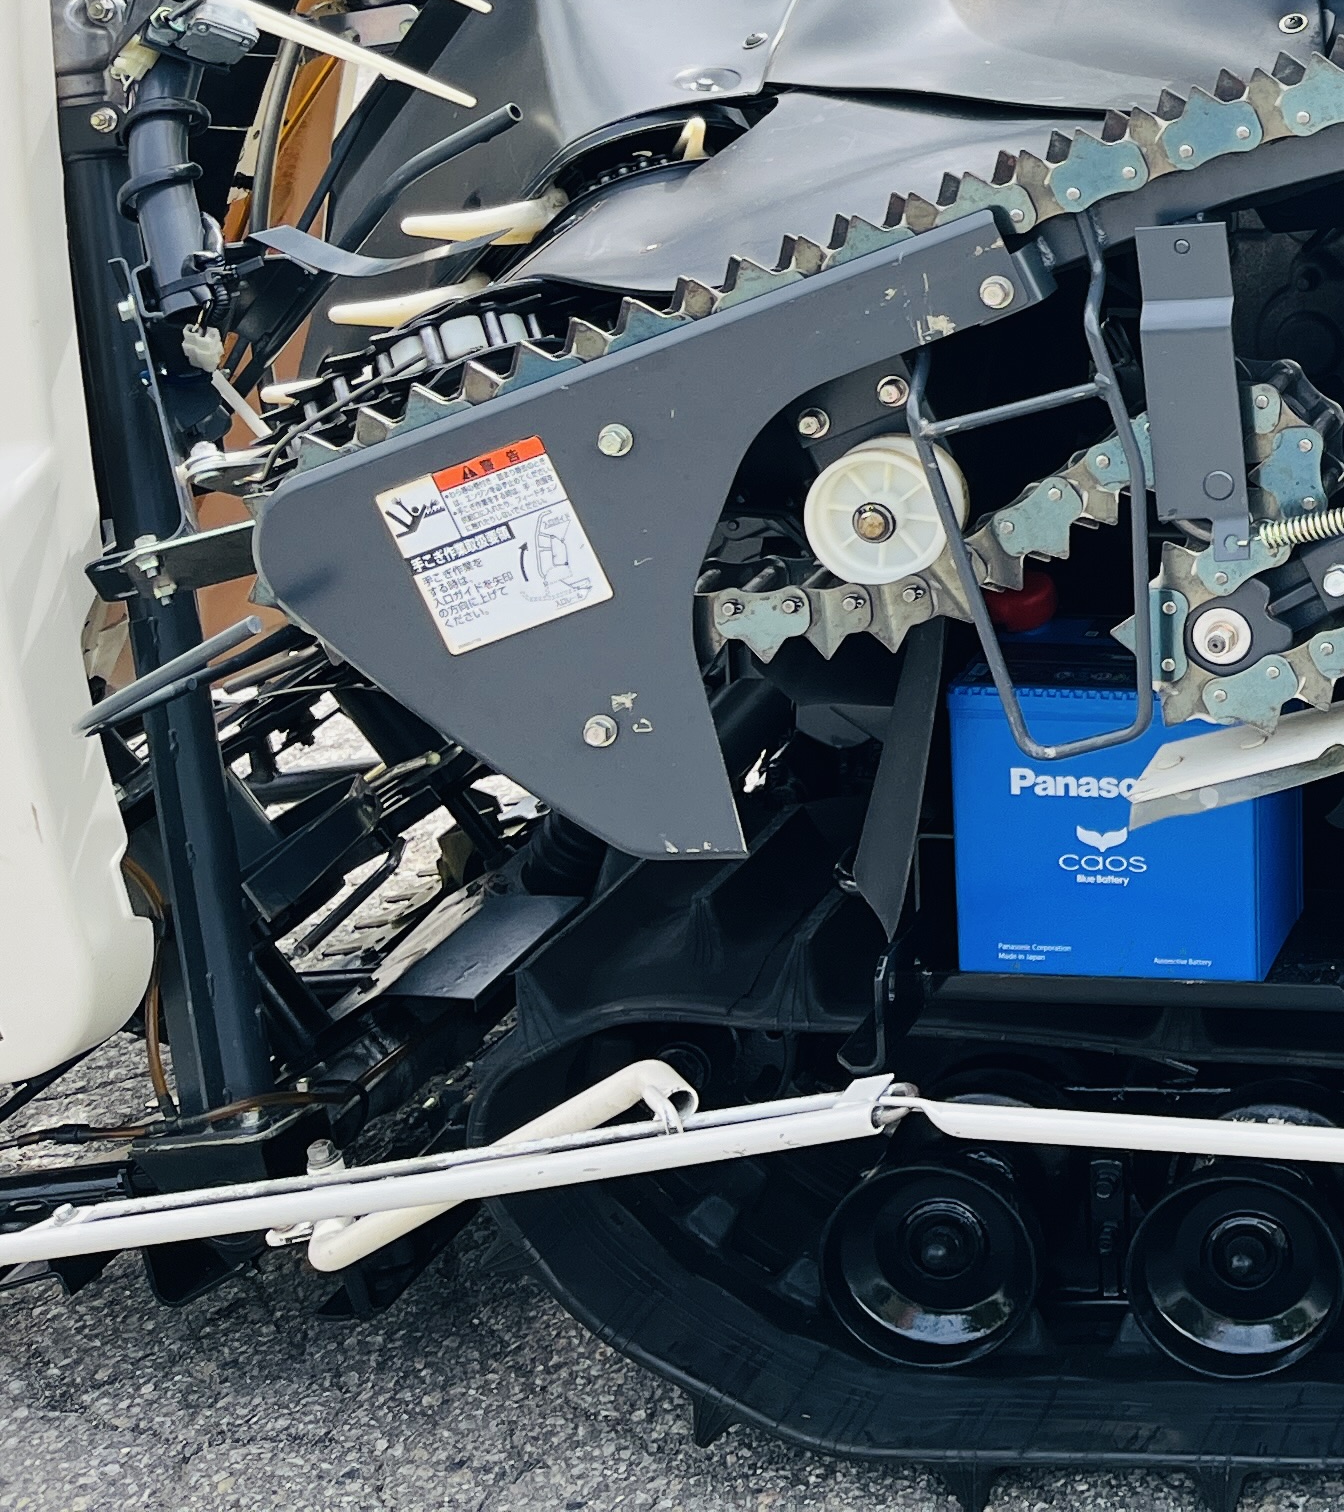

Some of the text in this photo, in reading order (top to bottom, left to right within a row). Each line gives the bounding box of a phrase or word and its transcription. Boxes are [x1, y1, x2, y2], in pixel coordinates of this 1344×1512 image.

[1009, 767, 1141, 799] Panaso
[1058, 852, 1148, 873] caos
[1076, 874, 1130, 886] Blue Battery
[1032, 943, 1072, 953] Corporation
[998, 952, 1017, 961] Made
[1026, 953, 1046, 963] Japan
[1188, 958, 1213, 968] Battery
